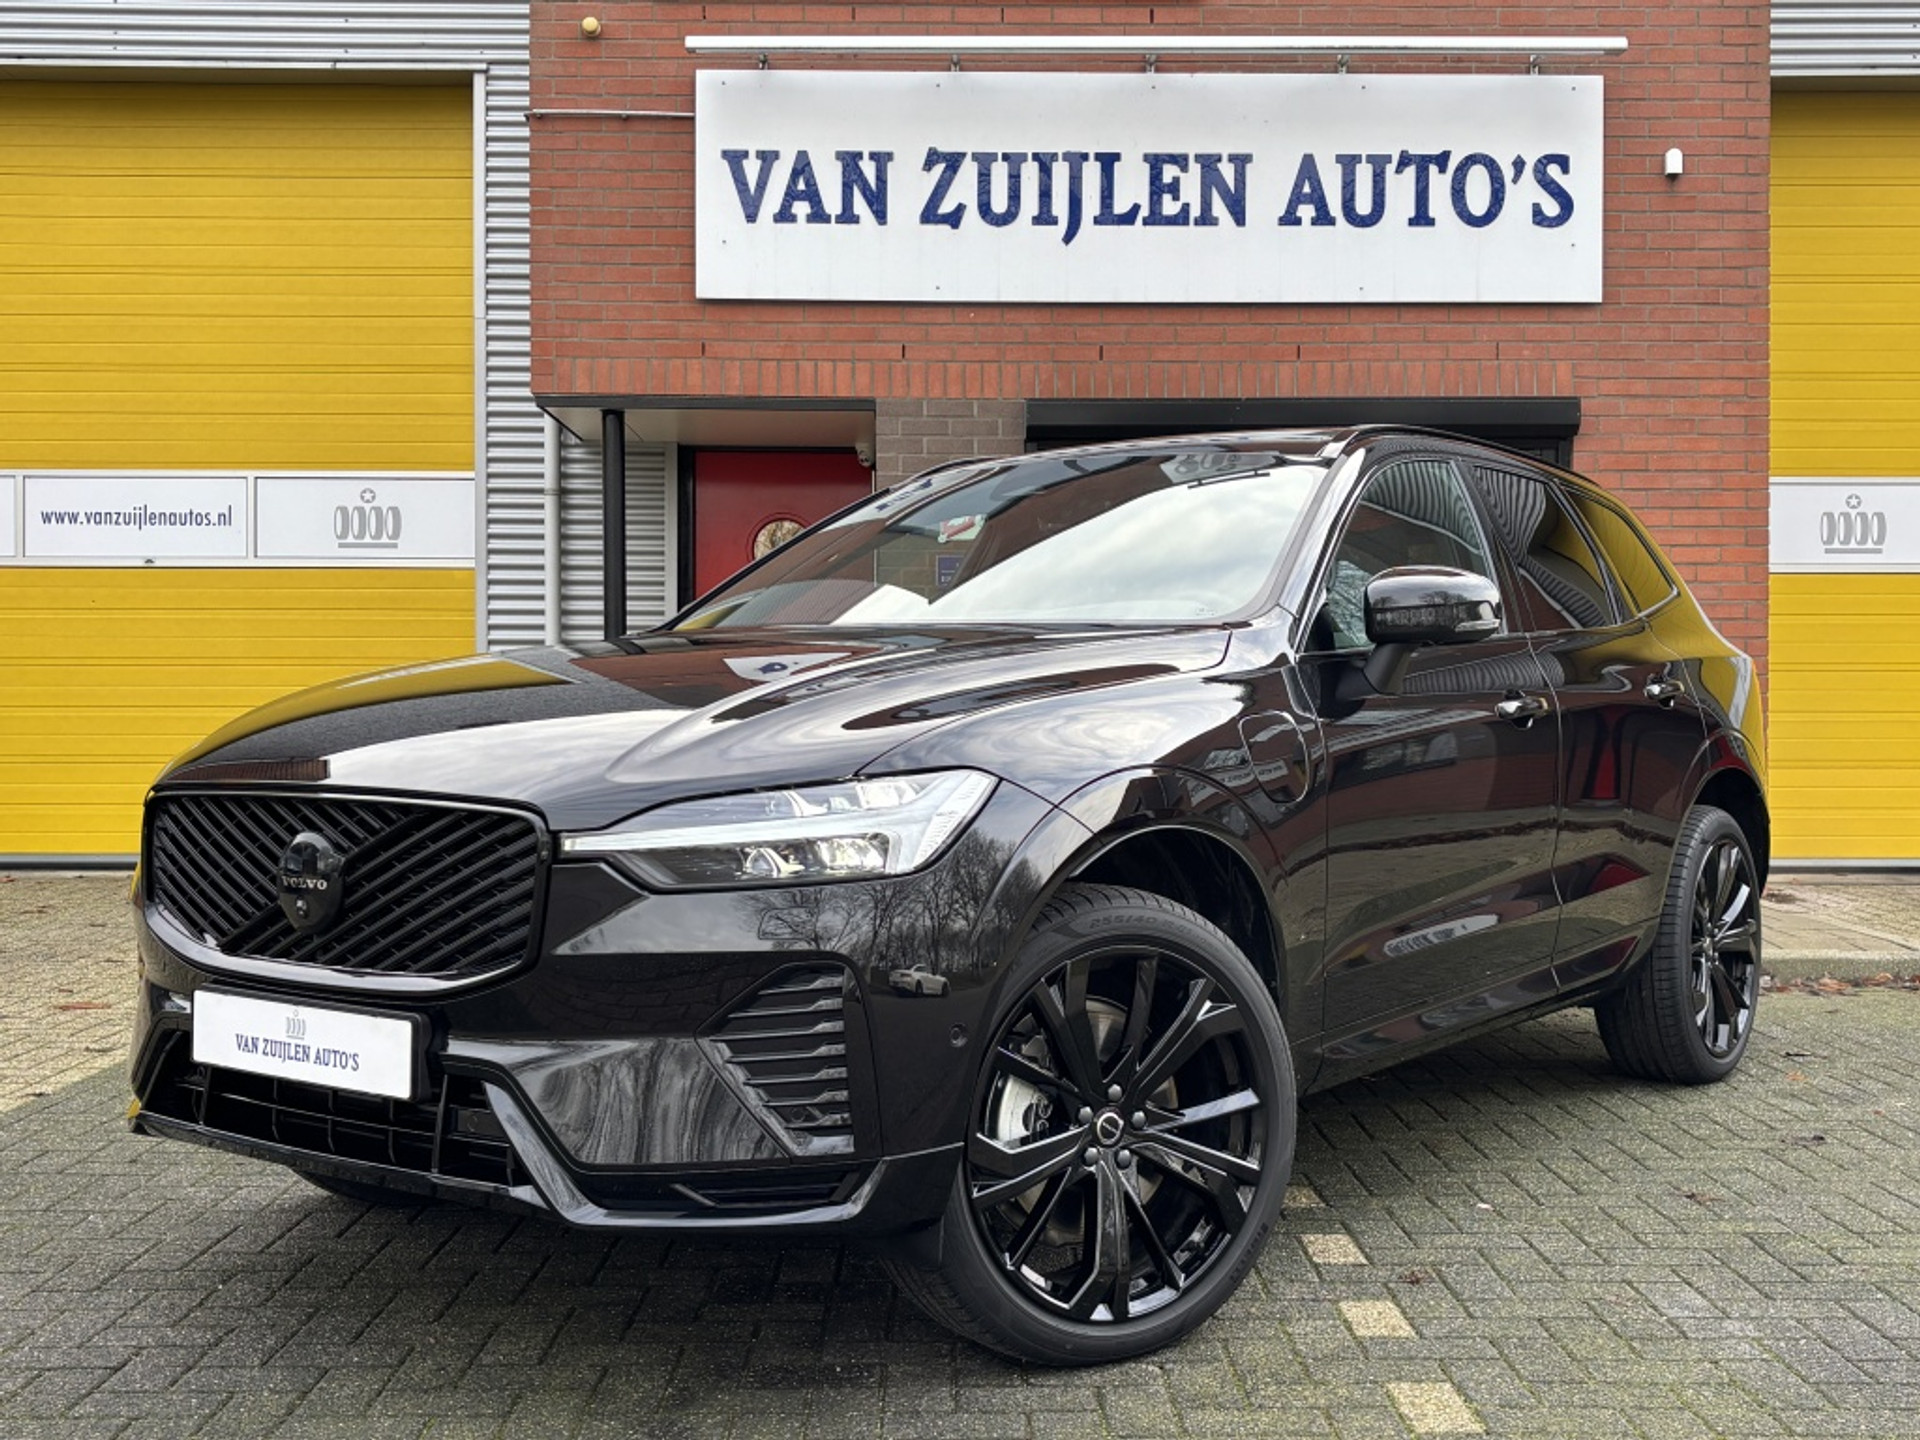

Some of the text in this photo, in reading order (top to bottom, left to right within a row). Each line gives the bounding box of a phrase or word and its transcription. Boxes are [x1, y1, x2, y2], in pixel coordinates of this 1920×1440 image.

[721, 146, 1575, 246] VAN ZUIJLEN AUTO'S
[40, 503, 233, 531] www.vanzuijlenautos.nl
[281, 875, 328, 891] VOLVO
[235, 1033, 360, 1072] VAN ZUIJLEN AUTO'S
